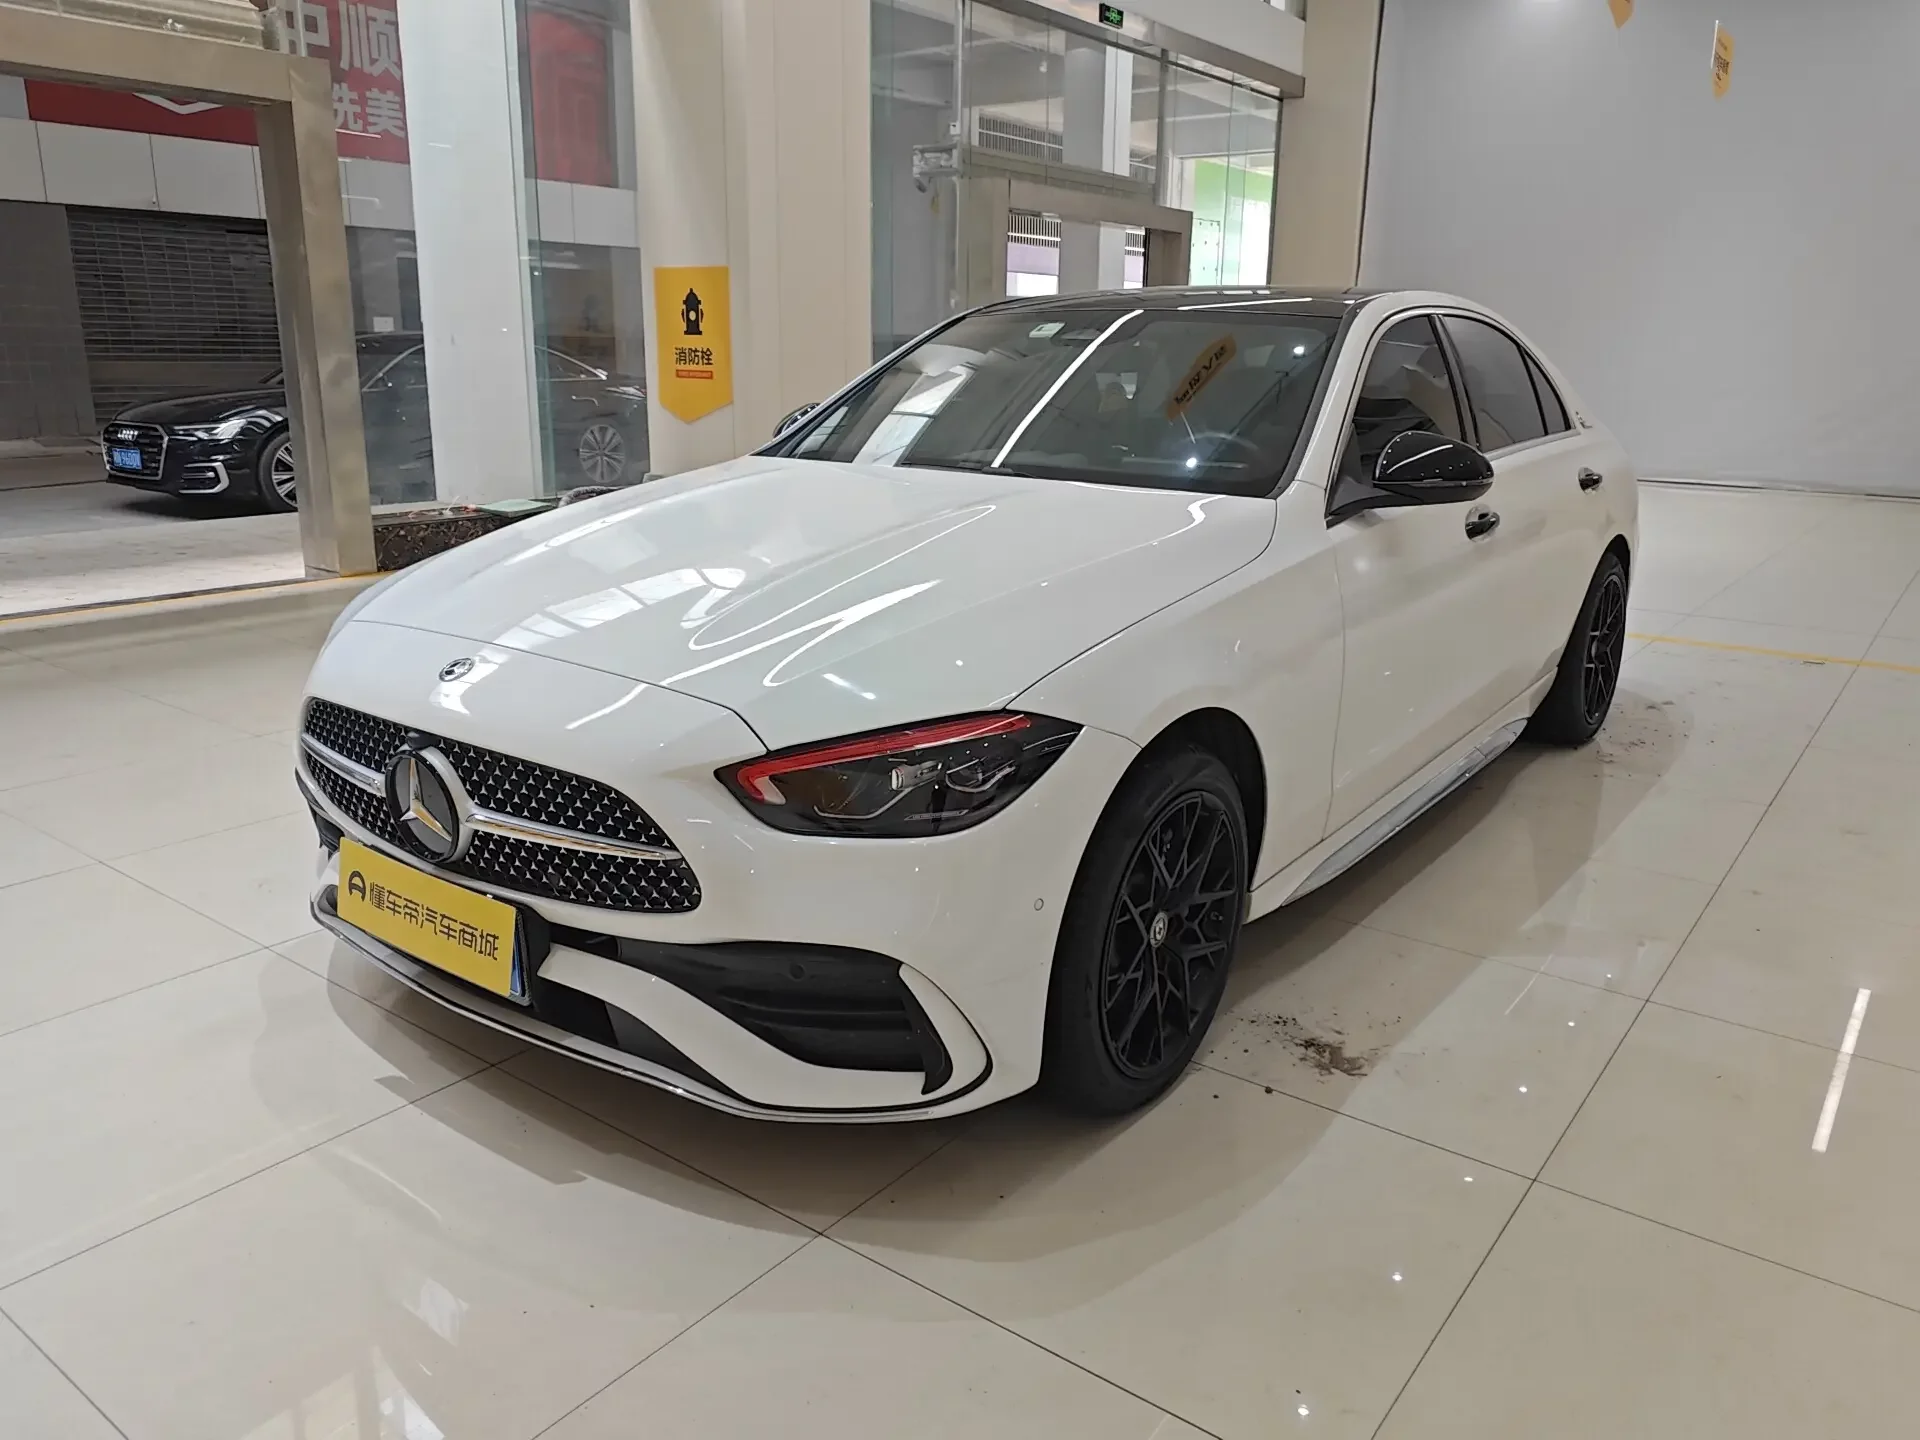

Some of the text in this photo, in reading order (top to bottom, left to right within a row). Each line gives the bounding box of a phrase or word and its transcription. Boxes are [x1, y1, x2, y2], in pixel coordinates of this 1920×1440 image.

[674, 347, 713, 366] 消防栓
[369, 881, 499, 961] 懂车帝汽车商城
